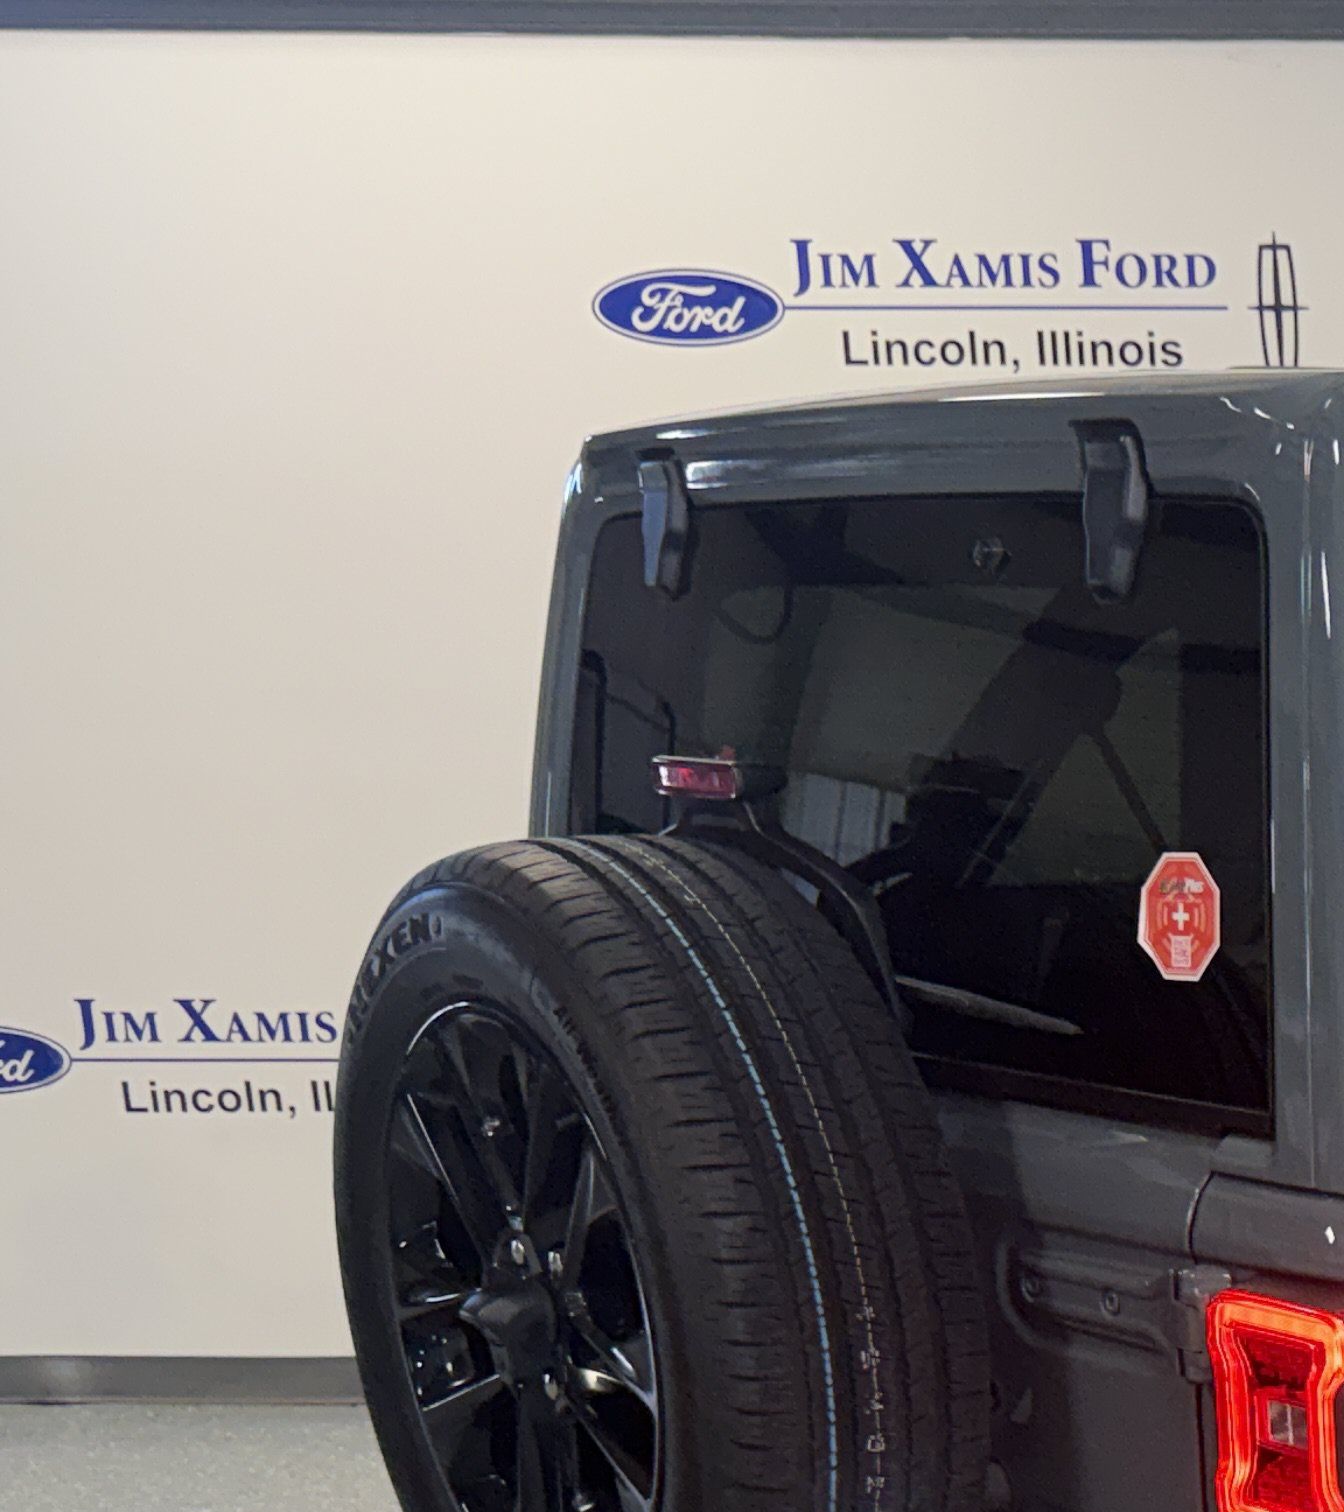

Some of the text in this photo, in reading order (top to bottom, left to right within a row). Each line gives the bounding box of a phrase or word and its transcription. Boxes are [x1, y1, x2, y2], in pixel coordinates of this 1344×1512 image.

[789, 238, 1217, 297] JIM XAMIS FORD
[631, 281, 747, 334] Ford
[842, 330, 1184, 372] Lincoln, Illinois
[73, 998, 339, 1051] JIM XAMIS
[121, 1079, 297, 1119] Lincoln,
